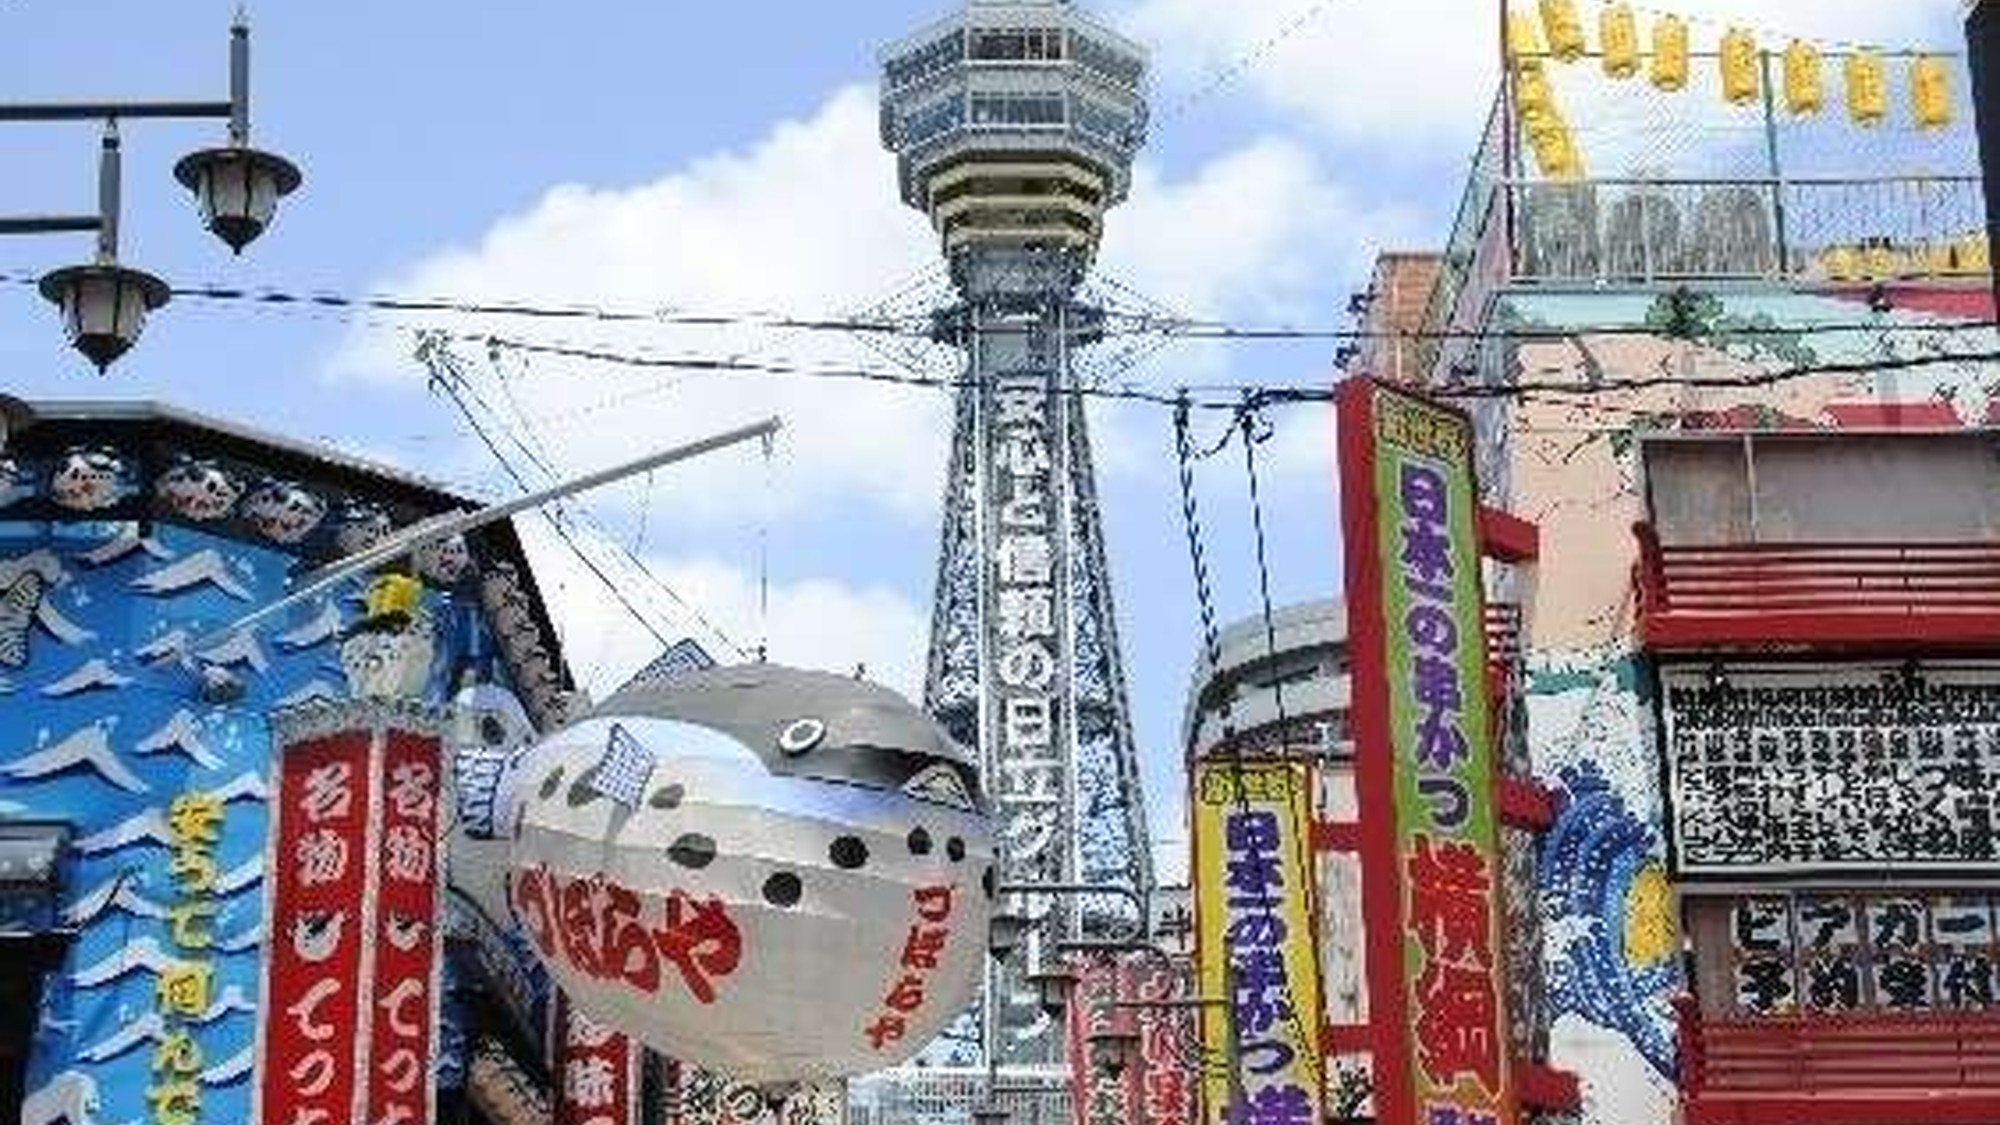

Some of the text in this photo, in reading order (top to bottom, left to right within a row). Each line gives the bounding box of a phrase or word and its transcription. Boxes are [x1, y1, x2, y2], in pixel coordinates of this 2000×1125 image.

[1401, 462, 1470, 827] 日本一の串かつ
[297, 761, 350, 887] 名物
[388, 762, 434, 884] 名物
[865, 885, 954, 1049] づぼらや
[1223, 811, 1295, 1074] 日本一の串かつ
